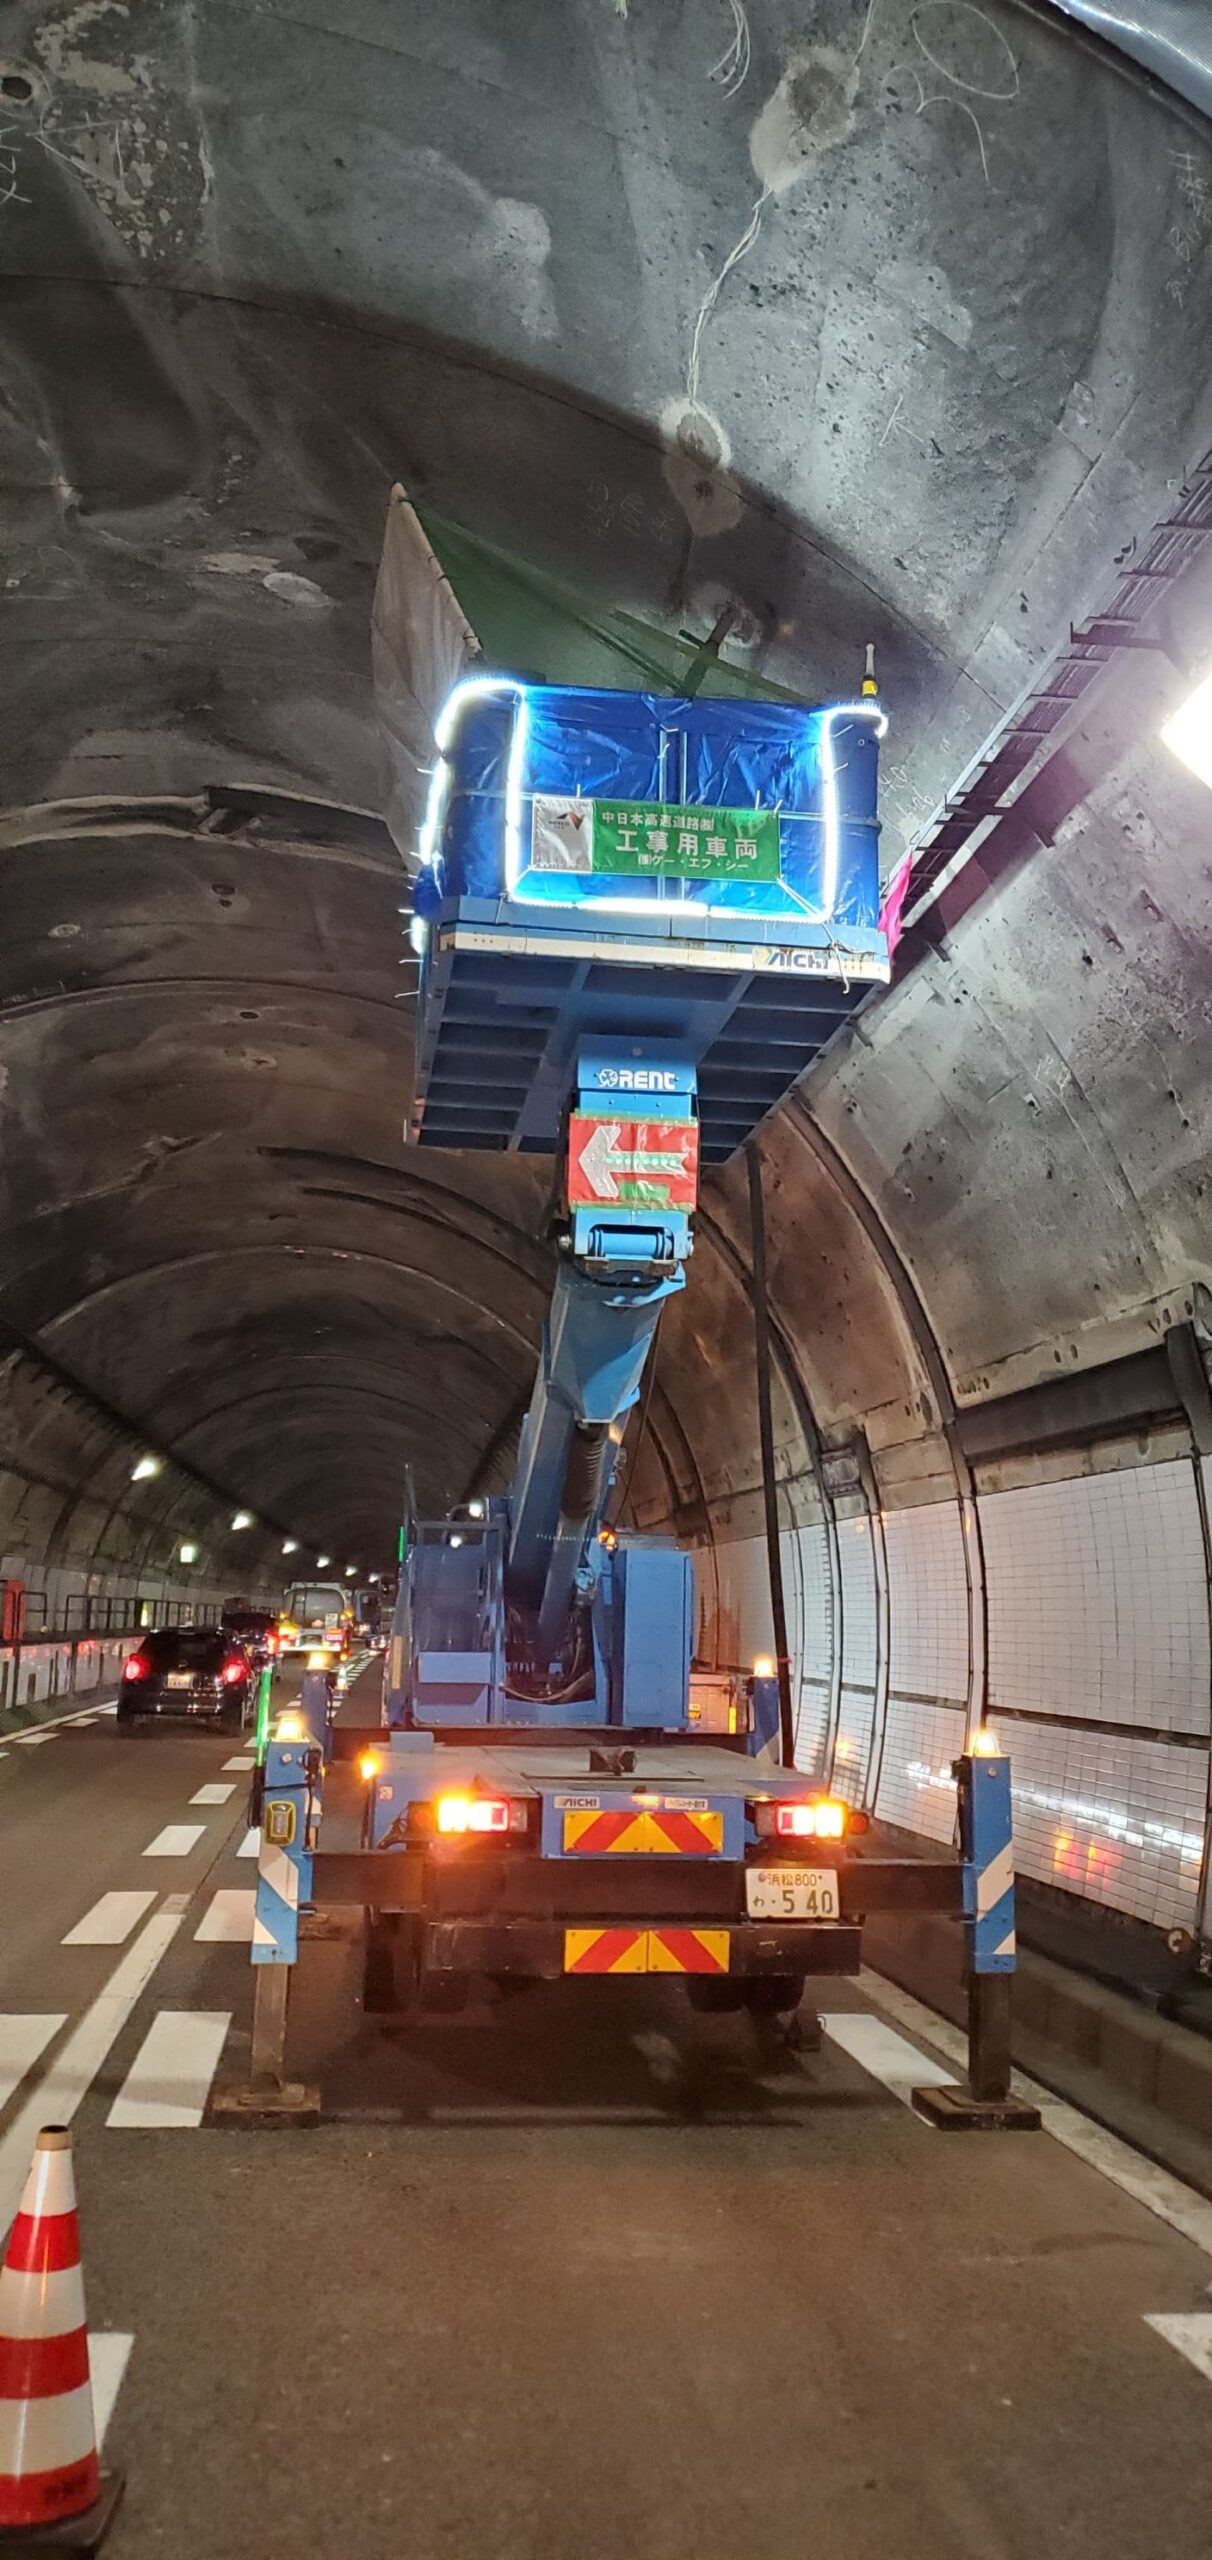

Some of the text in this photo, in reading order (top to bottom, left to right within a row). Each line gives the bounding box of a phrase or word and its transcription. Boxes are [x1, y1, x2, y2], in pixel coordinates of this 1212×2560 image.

[615, 829, 758, 860] 工事用車両
[768, 951, 829, 970] AICHI
[562, 1798, 598, 1807] AICHI
